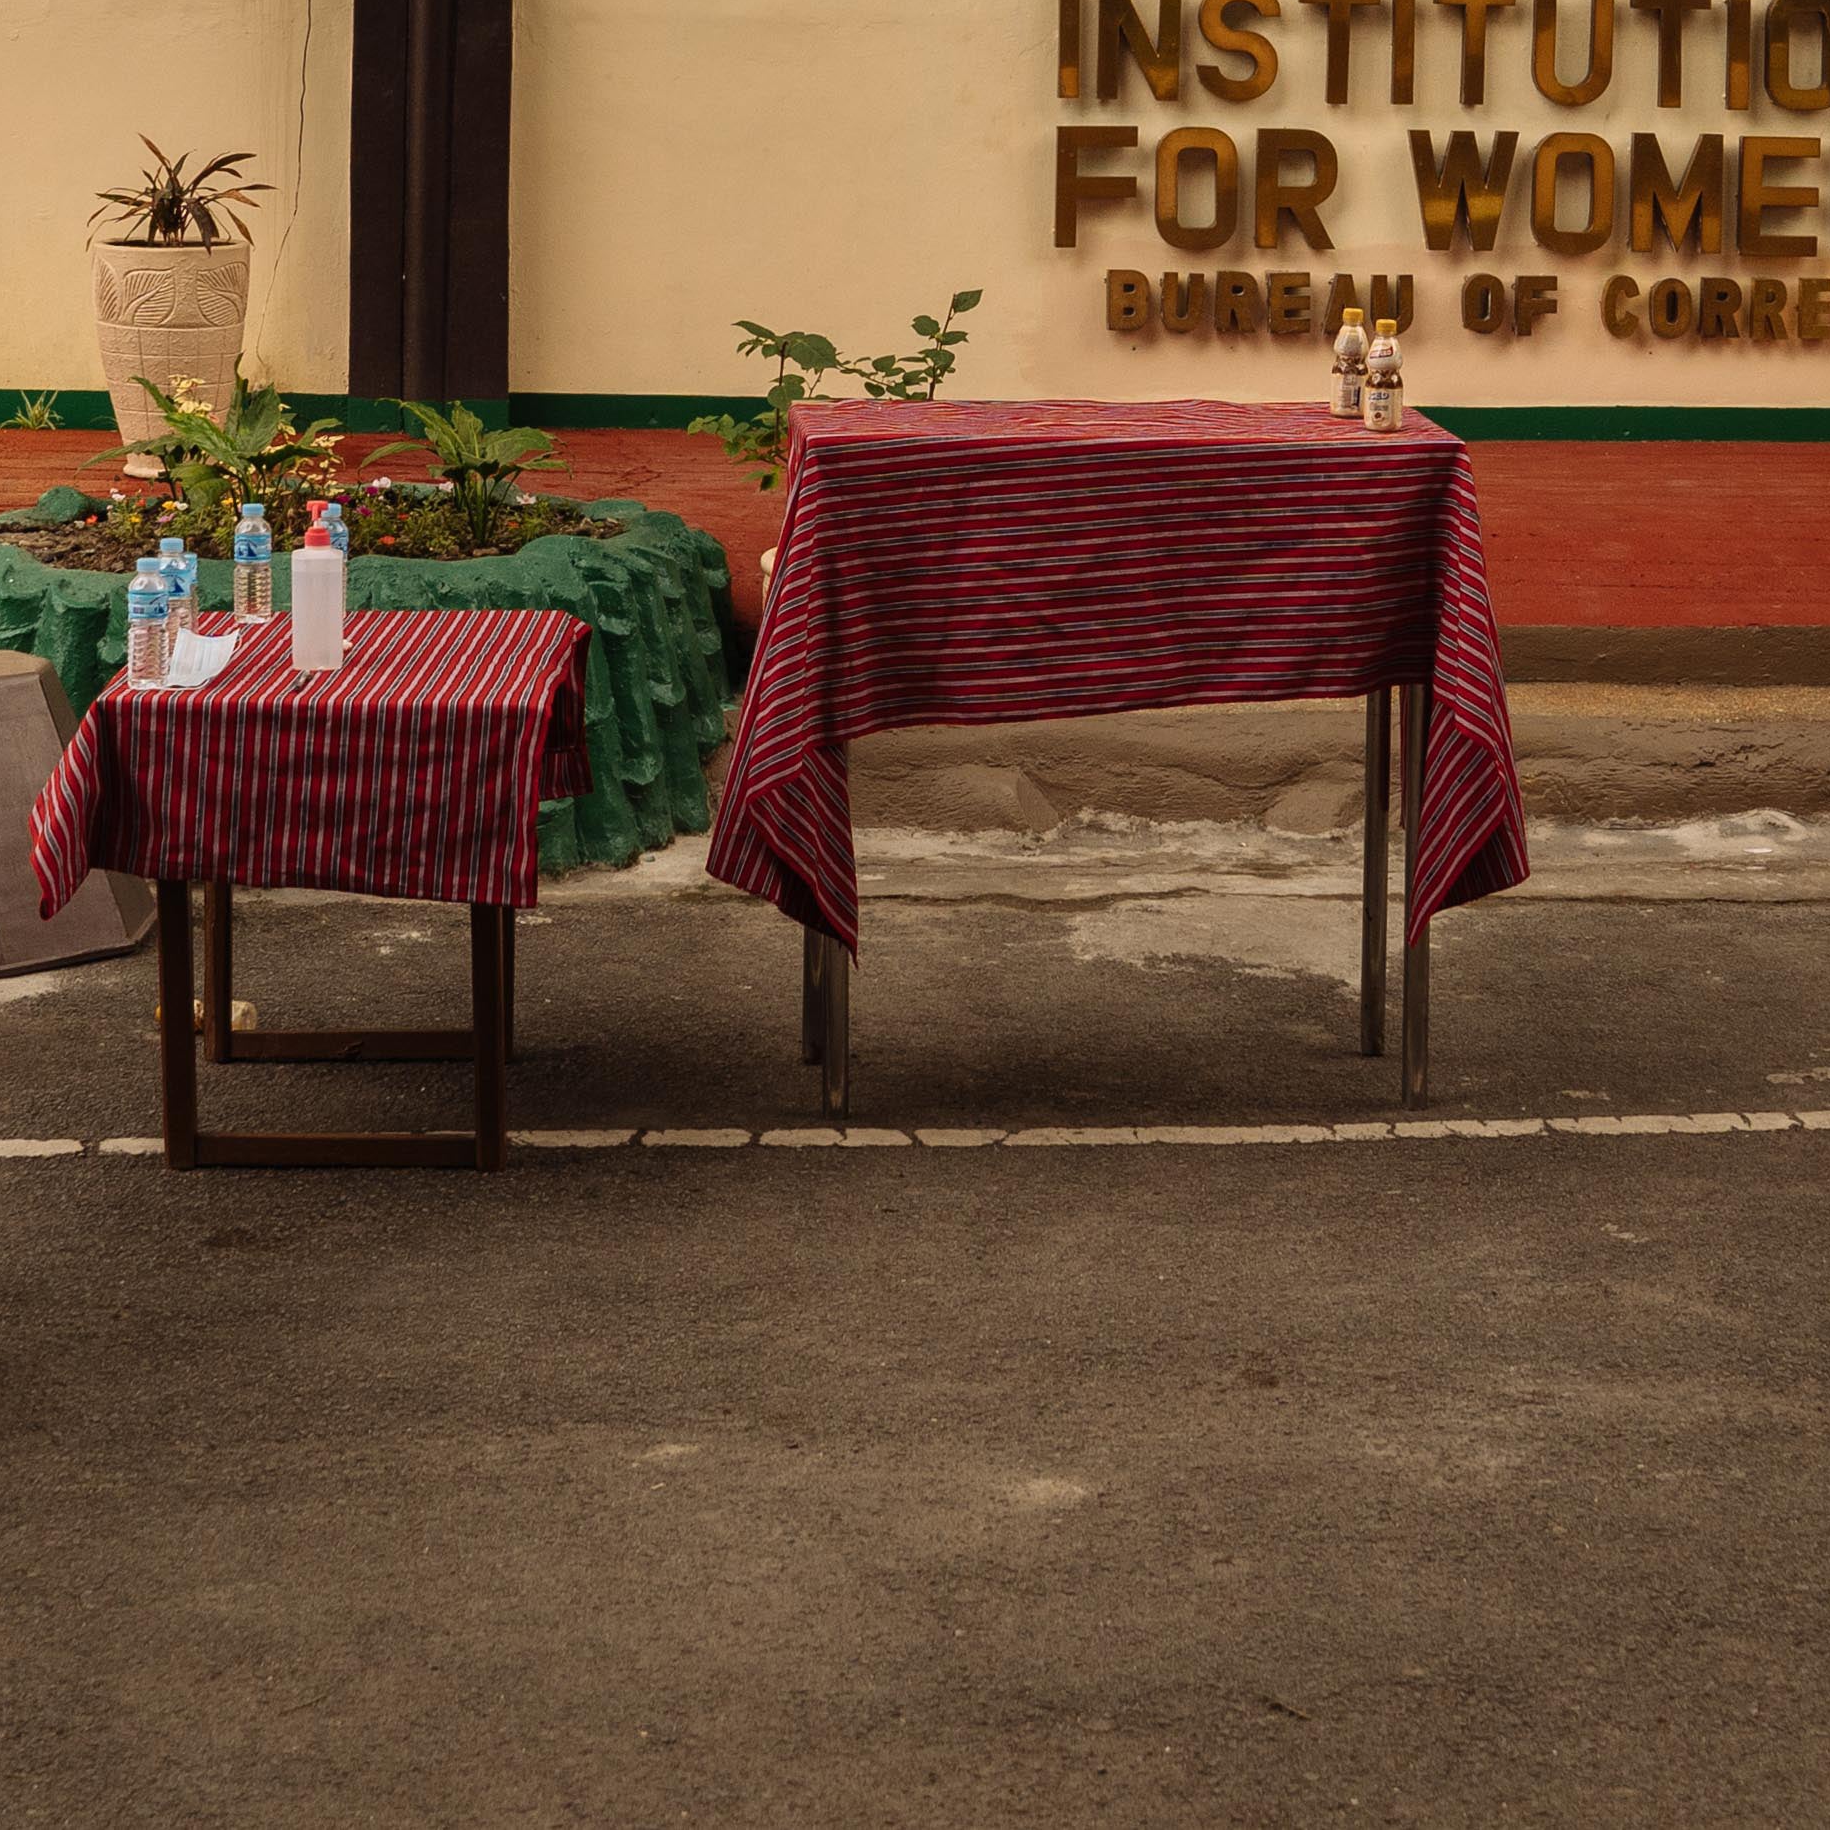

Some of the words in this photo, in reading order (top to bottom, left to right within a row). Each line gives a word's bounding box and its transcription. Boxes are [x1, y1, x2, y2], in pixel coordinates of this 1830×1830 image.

[1054, 125, 1339, 250] FOR
[1105, 268, 1415, 337] BUREAU
[1461, 273, 1560, 337] OF
